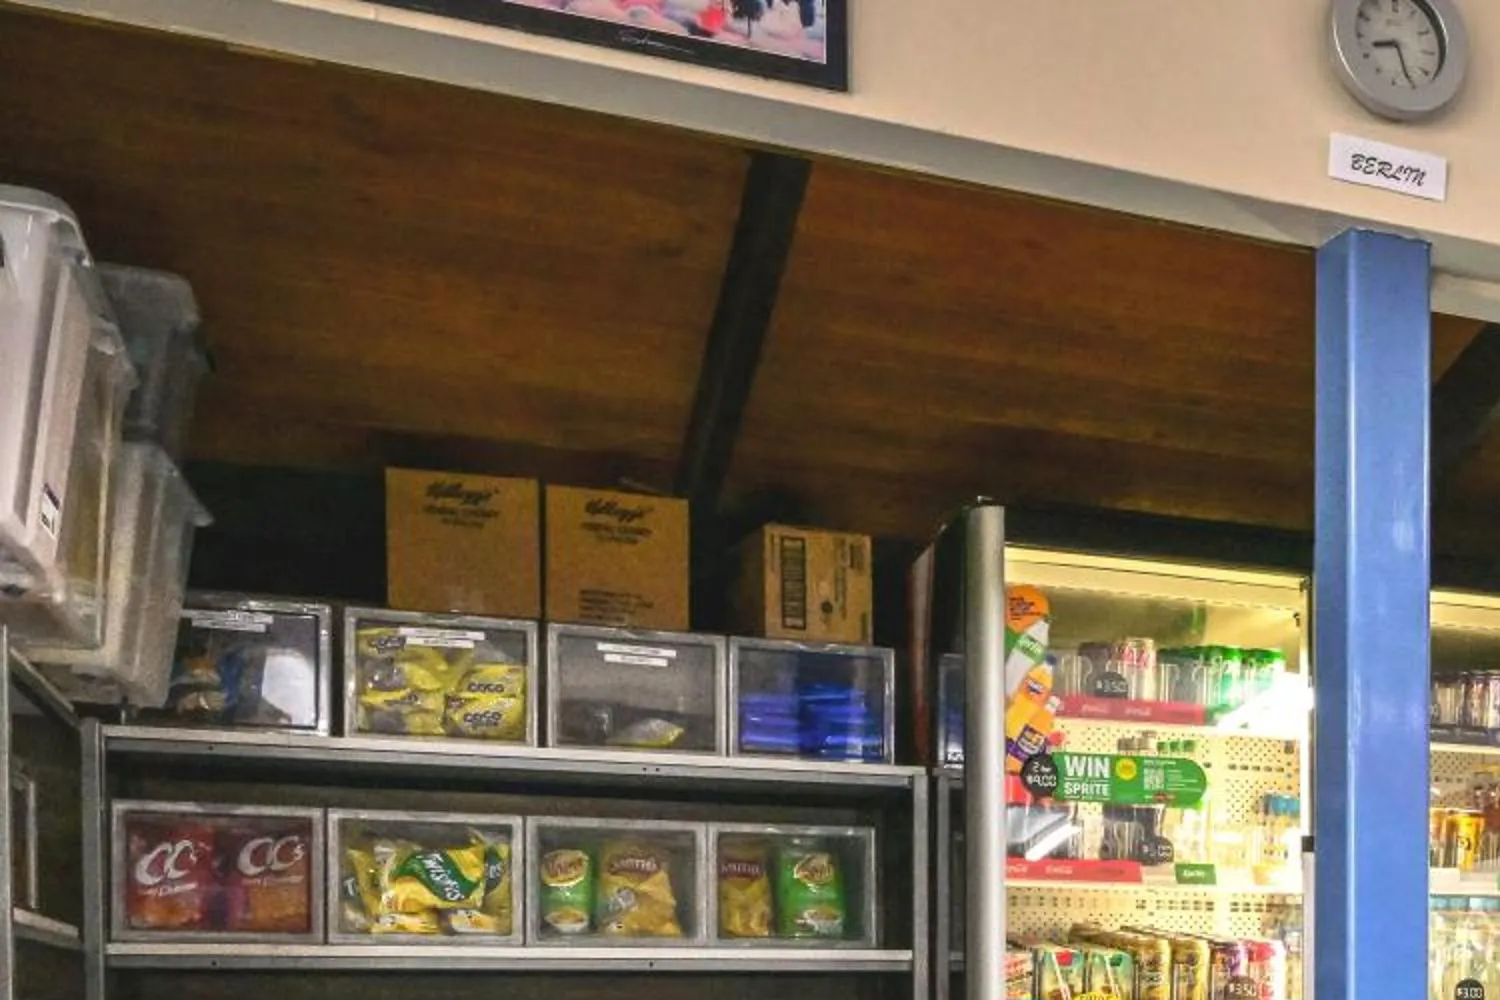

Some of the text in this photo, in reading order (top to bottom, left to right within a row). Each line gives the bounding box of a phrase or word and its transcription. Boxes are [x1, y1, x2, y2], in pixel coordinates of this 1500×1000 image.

[1350, 153, 1427, 186] BERLIN
[1063, 755, 1111, 777] WIN
[1063, 783, 1111, 797] SPRITE
